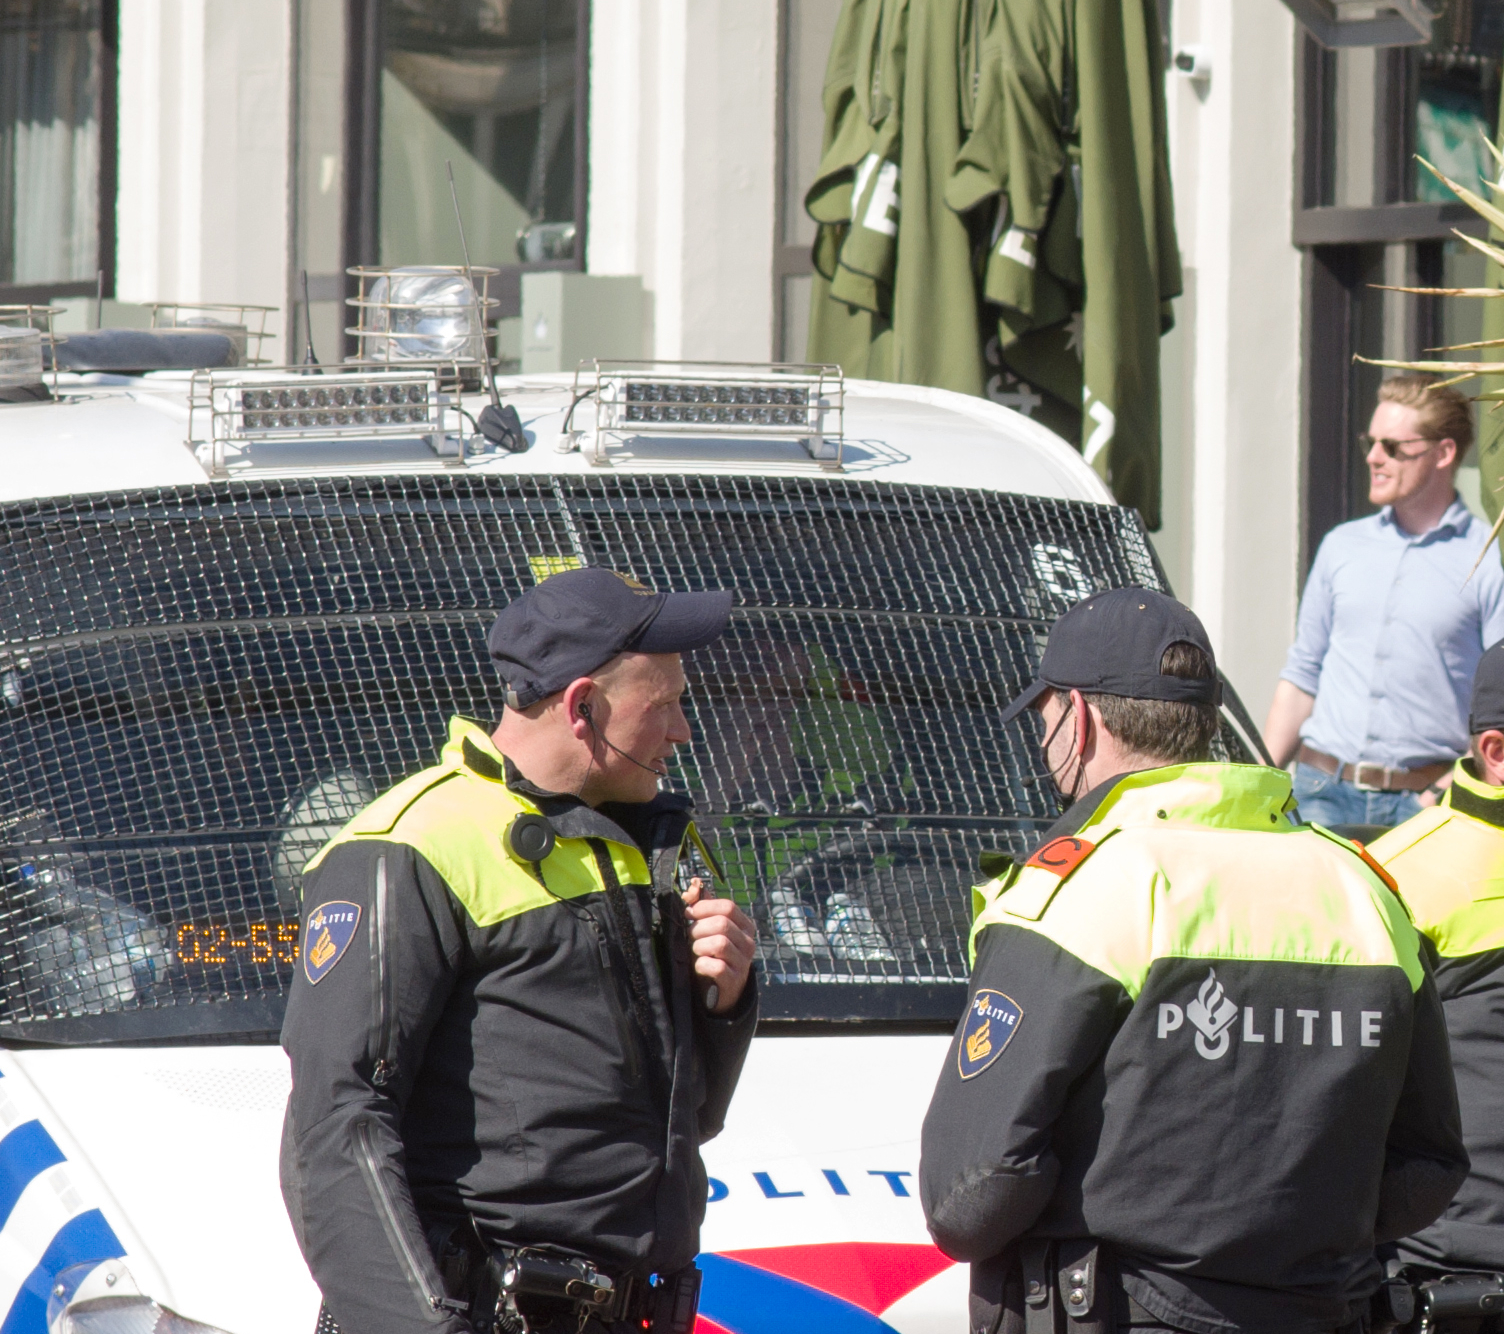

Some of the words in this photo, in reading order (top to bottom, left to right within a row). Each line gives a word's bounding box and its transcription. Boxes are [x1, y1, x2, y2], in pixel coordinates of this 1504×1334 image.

[1038, 838, 1081, 866] C
[309, 912, 354, 930] POLITIE
[974, 999, 1016, 1025] POLITIE
[1157, 1003, 1383, 1060] POLITIE
